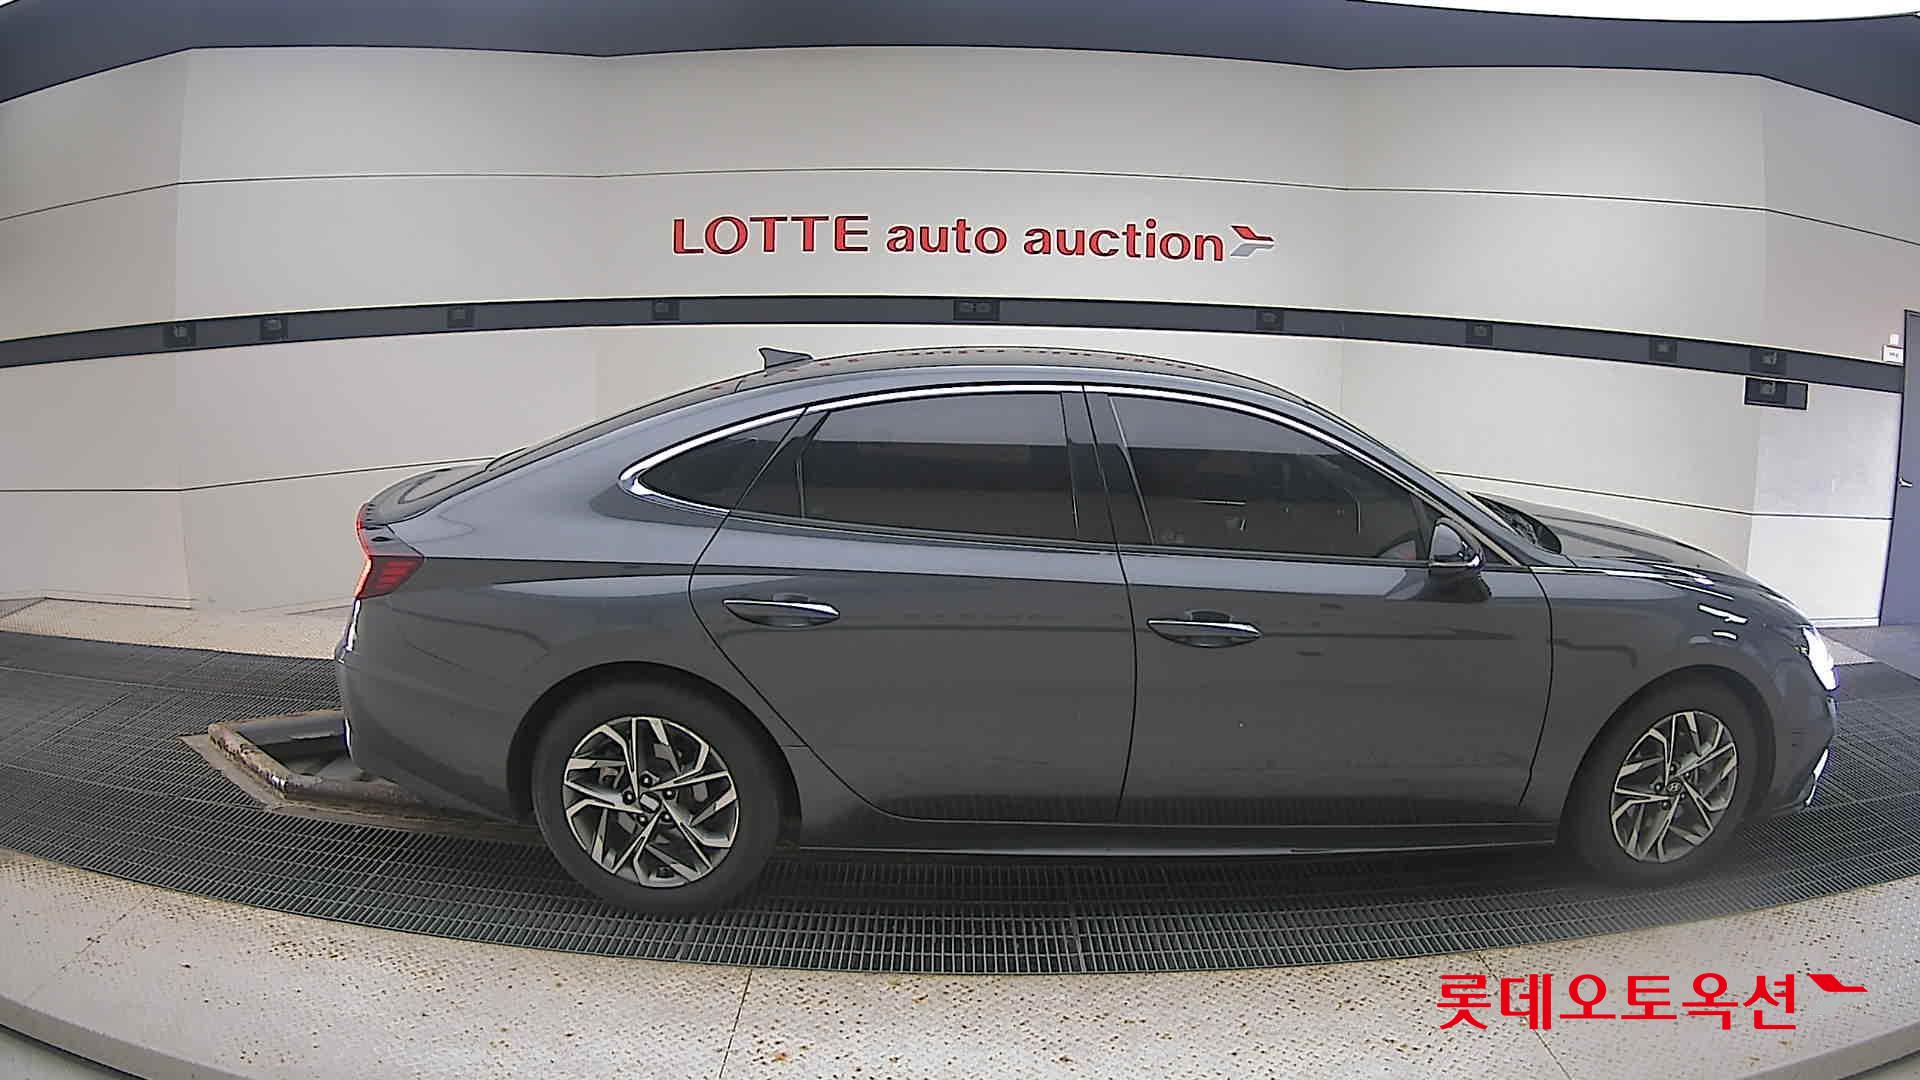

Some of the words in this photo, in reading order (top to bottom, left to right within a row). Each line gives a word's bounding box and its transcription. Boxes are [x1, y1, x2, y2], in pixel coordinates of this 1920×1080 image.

[672, 216, 869, 255] LOTTE
[886, 219, 1008, 254] auto
[1024, 219, 1225, 262] auction
